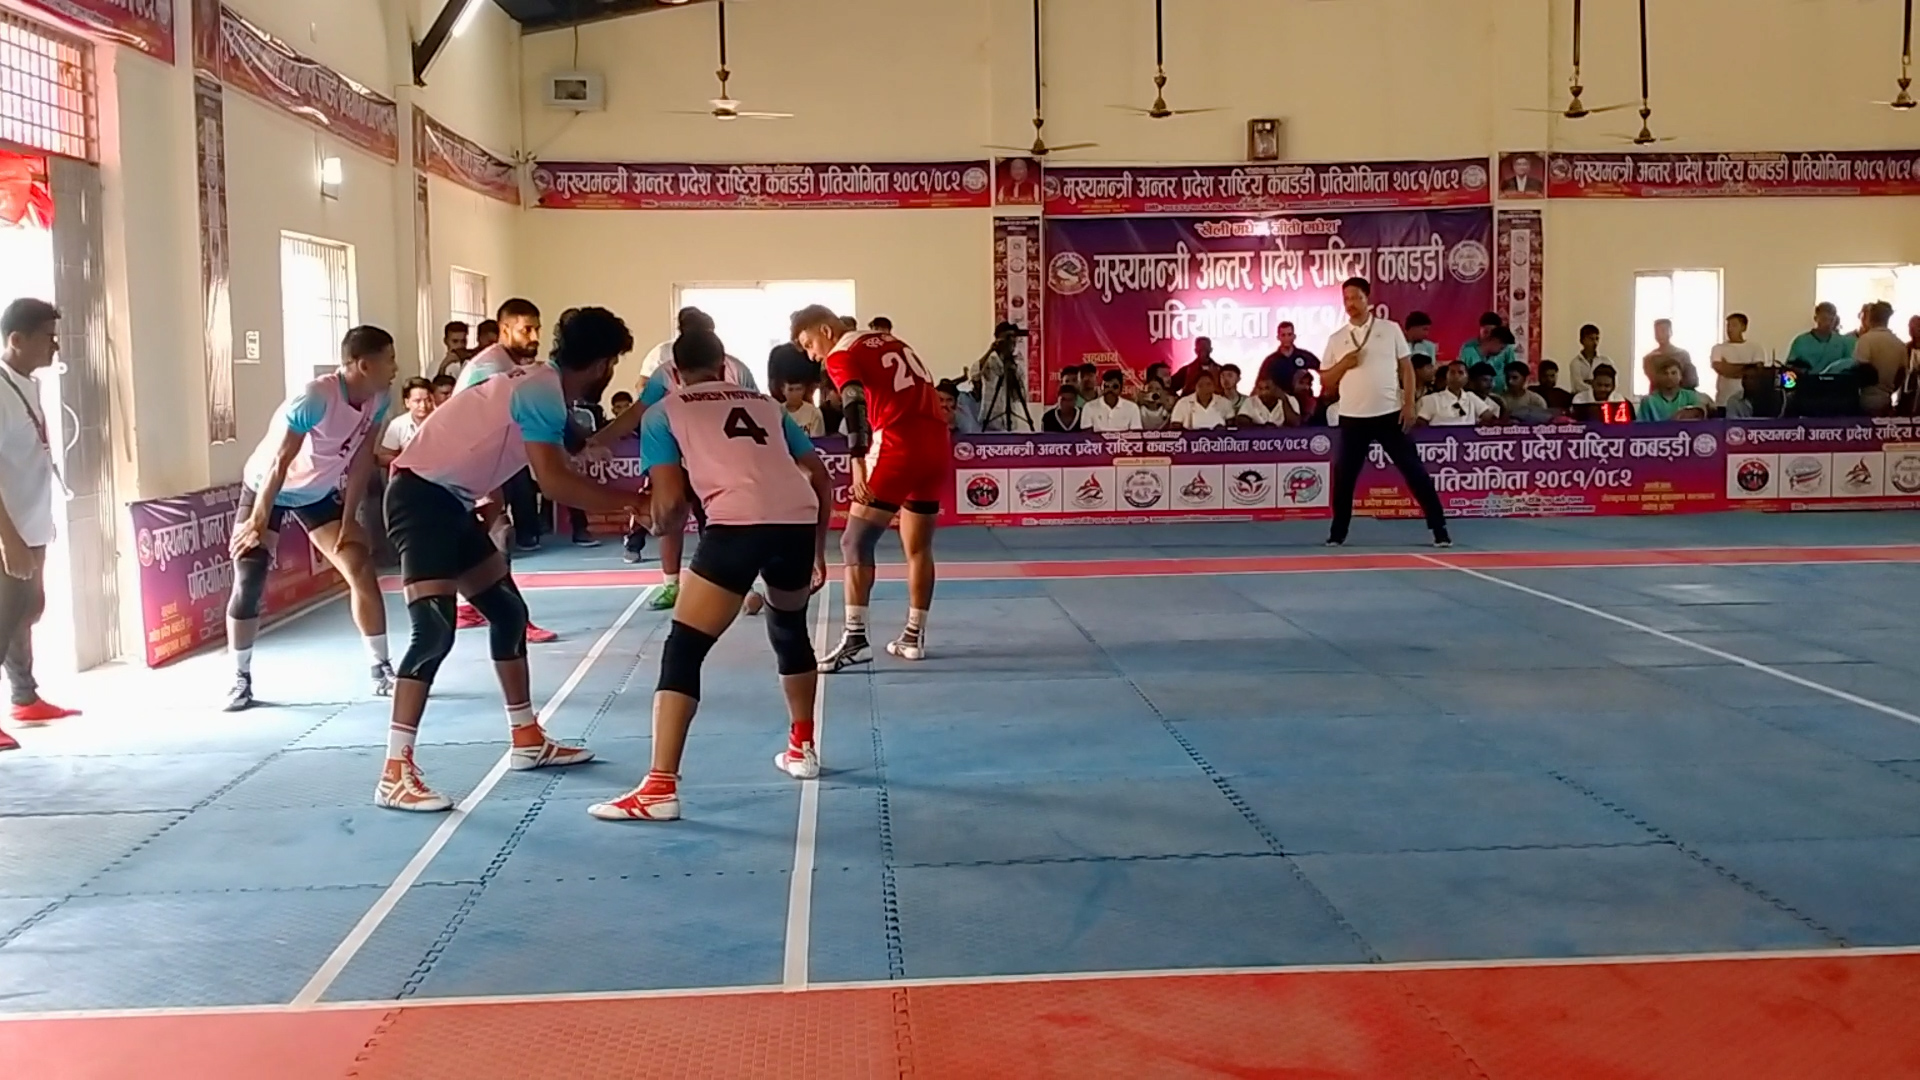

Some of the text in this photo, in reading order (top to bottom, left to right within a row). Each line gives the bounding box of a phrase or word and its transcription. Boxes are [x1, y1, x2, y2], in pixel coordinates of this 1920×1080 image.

[556, 166, 628, 199] मुख्यमन्त्री
[632, 173, 675, 195] अन्तर
[678, 167, 711, 197] प्रदेश
[819, 165, 890, 197] प्रतियोगिता
[893, 168, 961, 195] २०८१/०८२
[1063, 171, 1132, 205] मुख्यमन्त्री
[1136, 177, 1178, 199] अन्तर
[1181, 170, 1215, 200] प्रदेश
[1320, 165, 1389, 197] प्रतियोगिता
[1393, 167, 1460, 193] २०८१/०८२
[1573, 155, 1635, 188] मुख्यमन्त्री
[1636, 162, 1672, 183] अन्तर
[1674, 155, 1703, 185] प्रदेश
[1792, 153, 1851, 183] प्रतियोगिता
[1093, 240, 1191, 303] मुख्यमन्त्री
[1196, 251, 1255, 291] अन्तर
[1260, 236, 1304, 294] प्रदेश
[1377, 232, 1445, 290] कबड्डी
[1148, 297, 1271, 344] प्रतियोगिता
[881, 346, 933, 393] 20
[723, 406, 770, 446] 4
[1600, 401, 1628, 424] 14
[976, 441, 1035, 459] मुख्यमन्त्री
[1037, 443, 1073, 457] अन्तर
[1075, 440, 1103, 457] प्रदेश
[1190, 436, 1249, 454] प्रतियोगिता
[1252, 437, 1309, 452] २०८१/०८२
[1463, 440, 1517, 462] अन्तर
[1521, 434, 1563, 462] प्रदेश
[1567, 432, 1626, 464] राष्ट्रिय
[1747, 425, 1806, 444] मुख्यमन्त्री
[1808, 428, 1843, 441] अन्तर
[1846, 424, 1873, 441] प्रदेश
[1534, 466, 1632, 490] २०८१/०८२
[152, 510, 200, 572] मुख्यमन्त्री
[201, 512, 226, 549] अन्तर
